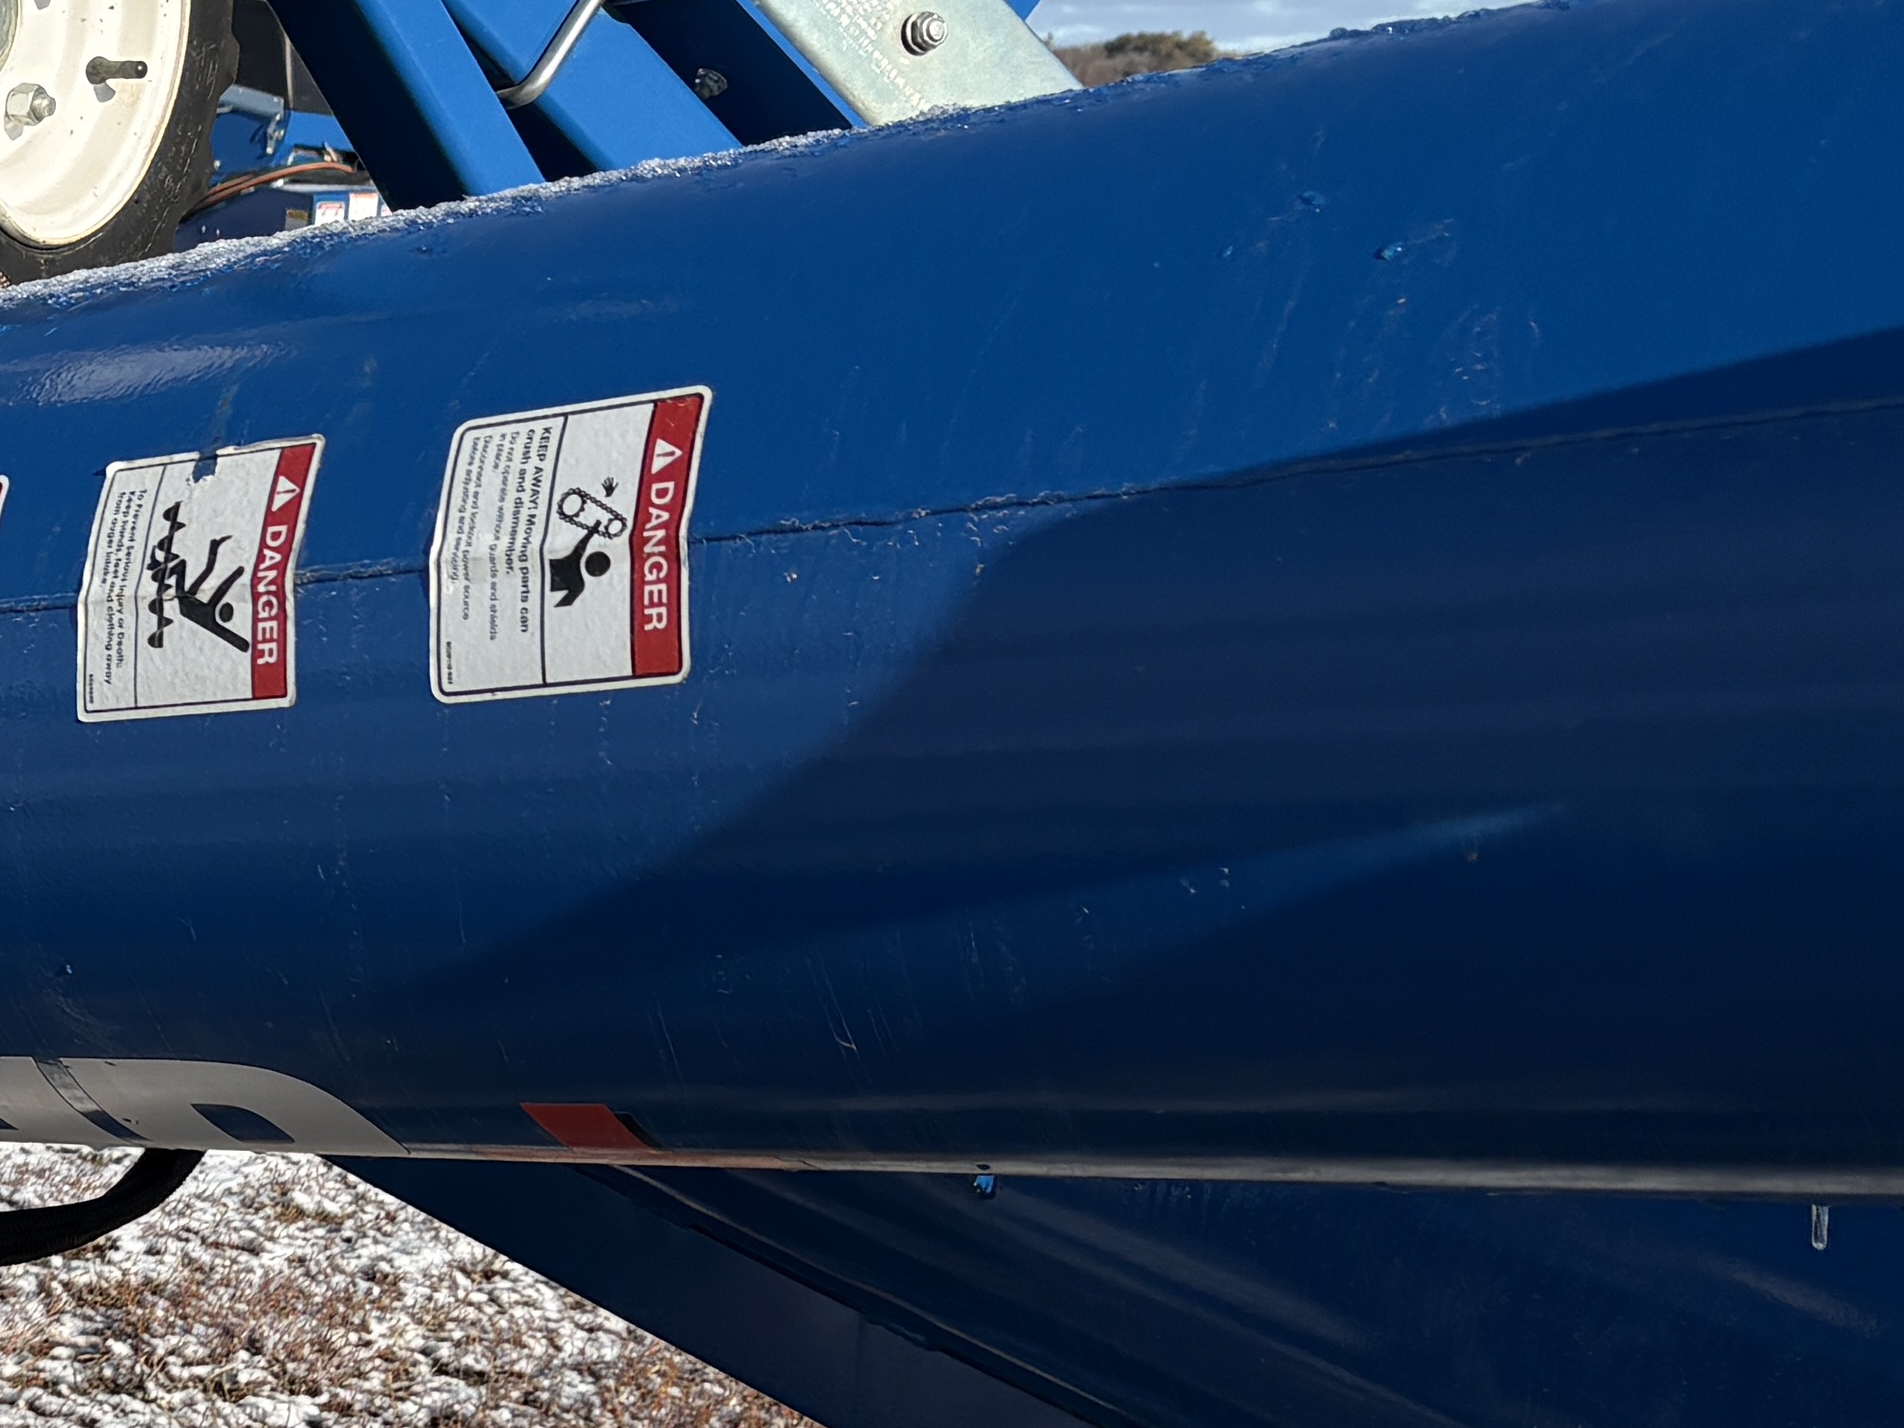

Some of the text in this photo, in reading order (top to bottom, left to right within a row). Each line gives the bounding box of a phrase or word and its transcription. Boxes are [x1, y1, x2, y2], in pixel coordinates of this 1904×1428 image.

[520, 429, 535, 464] crush
[137, 490, 148, 500] To
[516, 469, 527, 493] and
[122, 491, 136, 517] Keep
[128, 504, 143, 542] Prevent
[518, 427, 553, 632] KEEP AWAY! Moving parts can
[112, 558, 122, 579] feet
[121, 546, 134, 581] Serious
[643, 481, 674, 630] DANGER
[107, 582, 115, 602] and
[115, 585, 127, 614] Injury
[257, 525, 288, 664] DANGER
[105, 606, 115, 651] clothing
[118, 618, 124, 629] or
[104, 654, 112, 684] away
